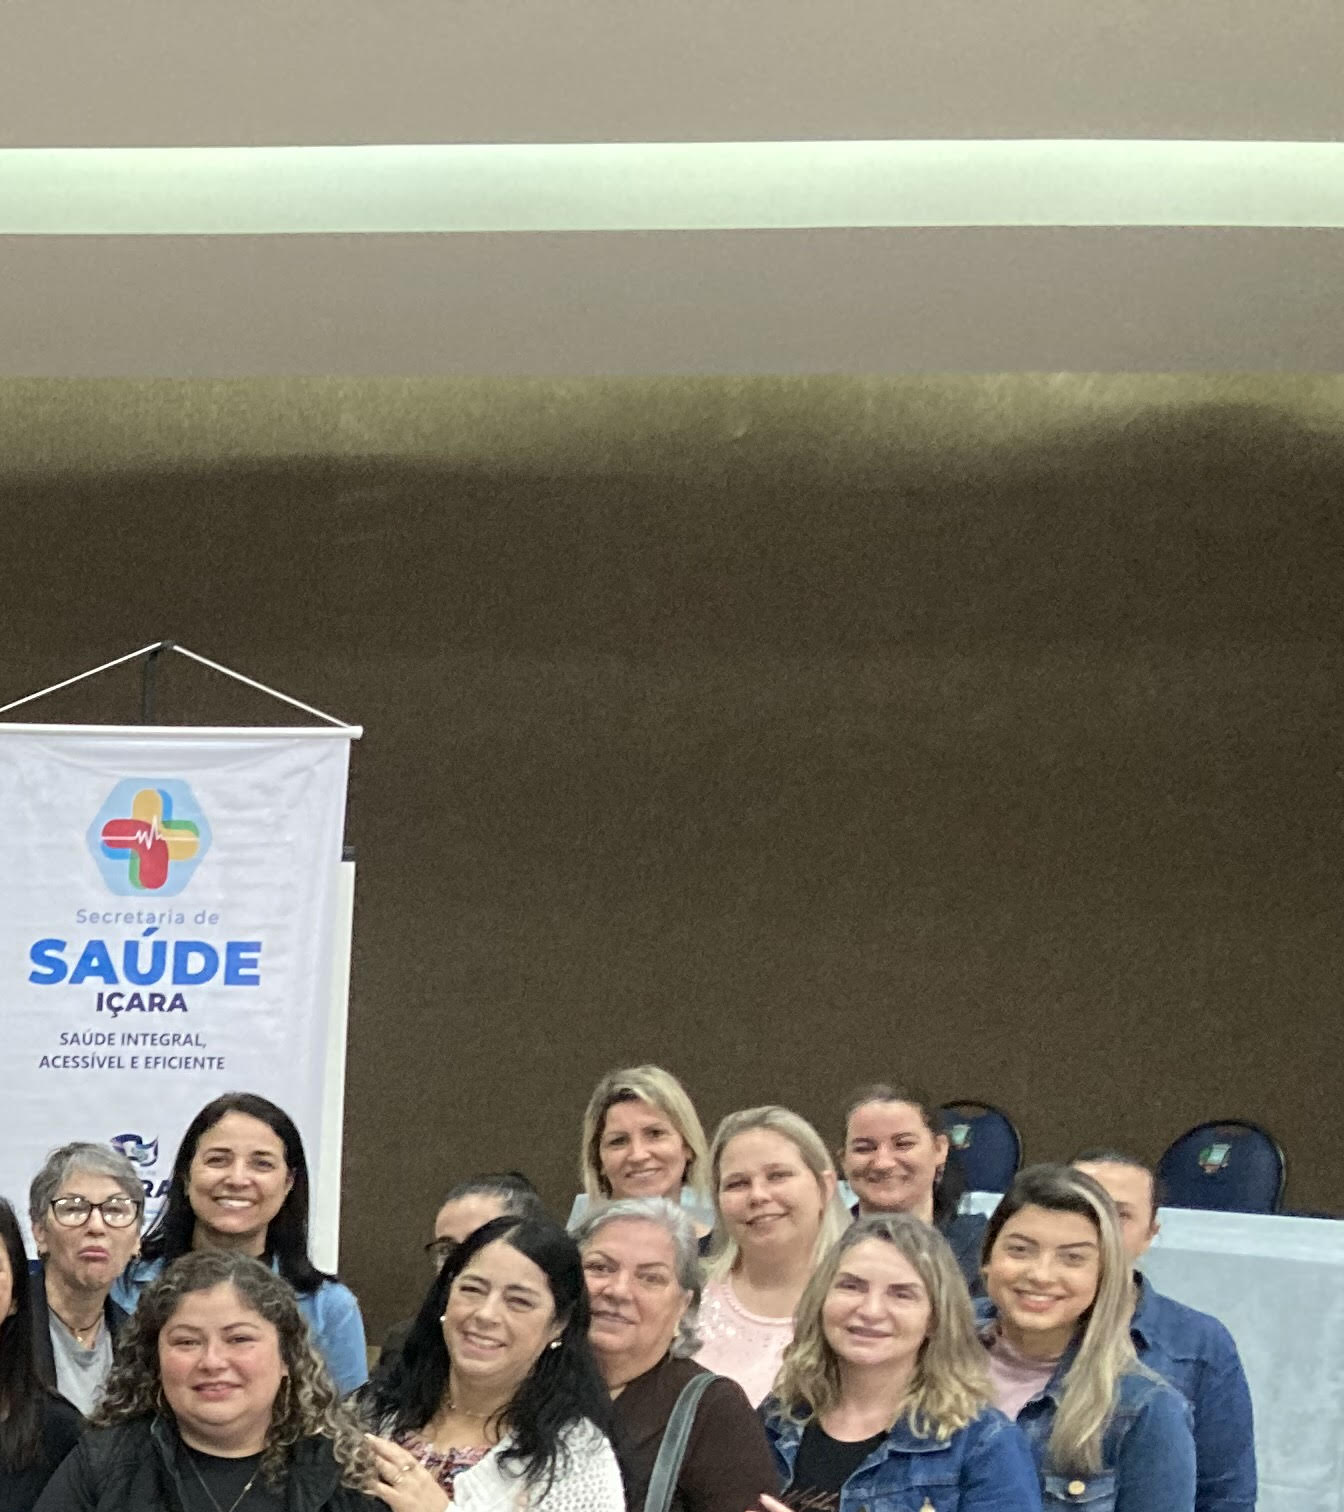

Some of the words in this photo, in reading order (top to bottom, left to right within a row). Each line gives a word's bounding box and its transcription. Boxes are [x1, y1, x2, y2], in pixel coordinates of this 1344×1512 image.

[76, 909, 185, 925] Secretaria
[193, 909, 220, 926] de
[28, 926, 262, 986] SAÚDE
[96, 992, 188, 1018] IÇARA
[60, 1029, 115, 1047] SAÚDE
[121, 1032, 207, 1049] INTEGRAL,
[39, 1052, 124, 1069] ACESSÍVEL
[131, 1056, 139, 1069] E
[144, 1056, 225, 1070] EFICIENTE
